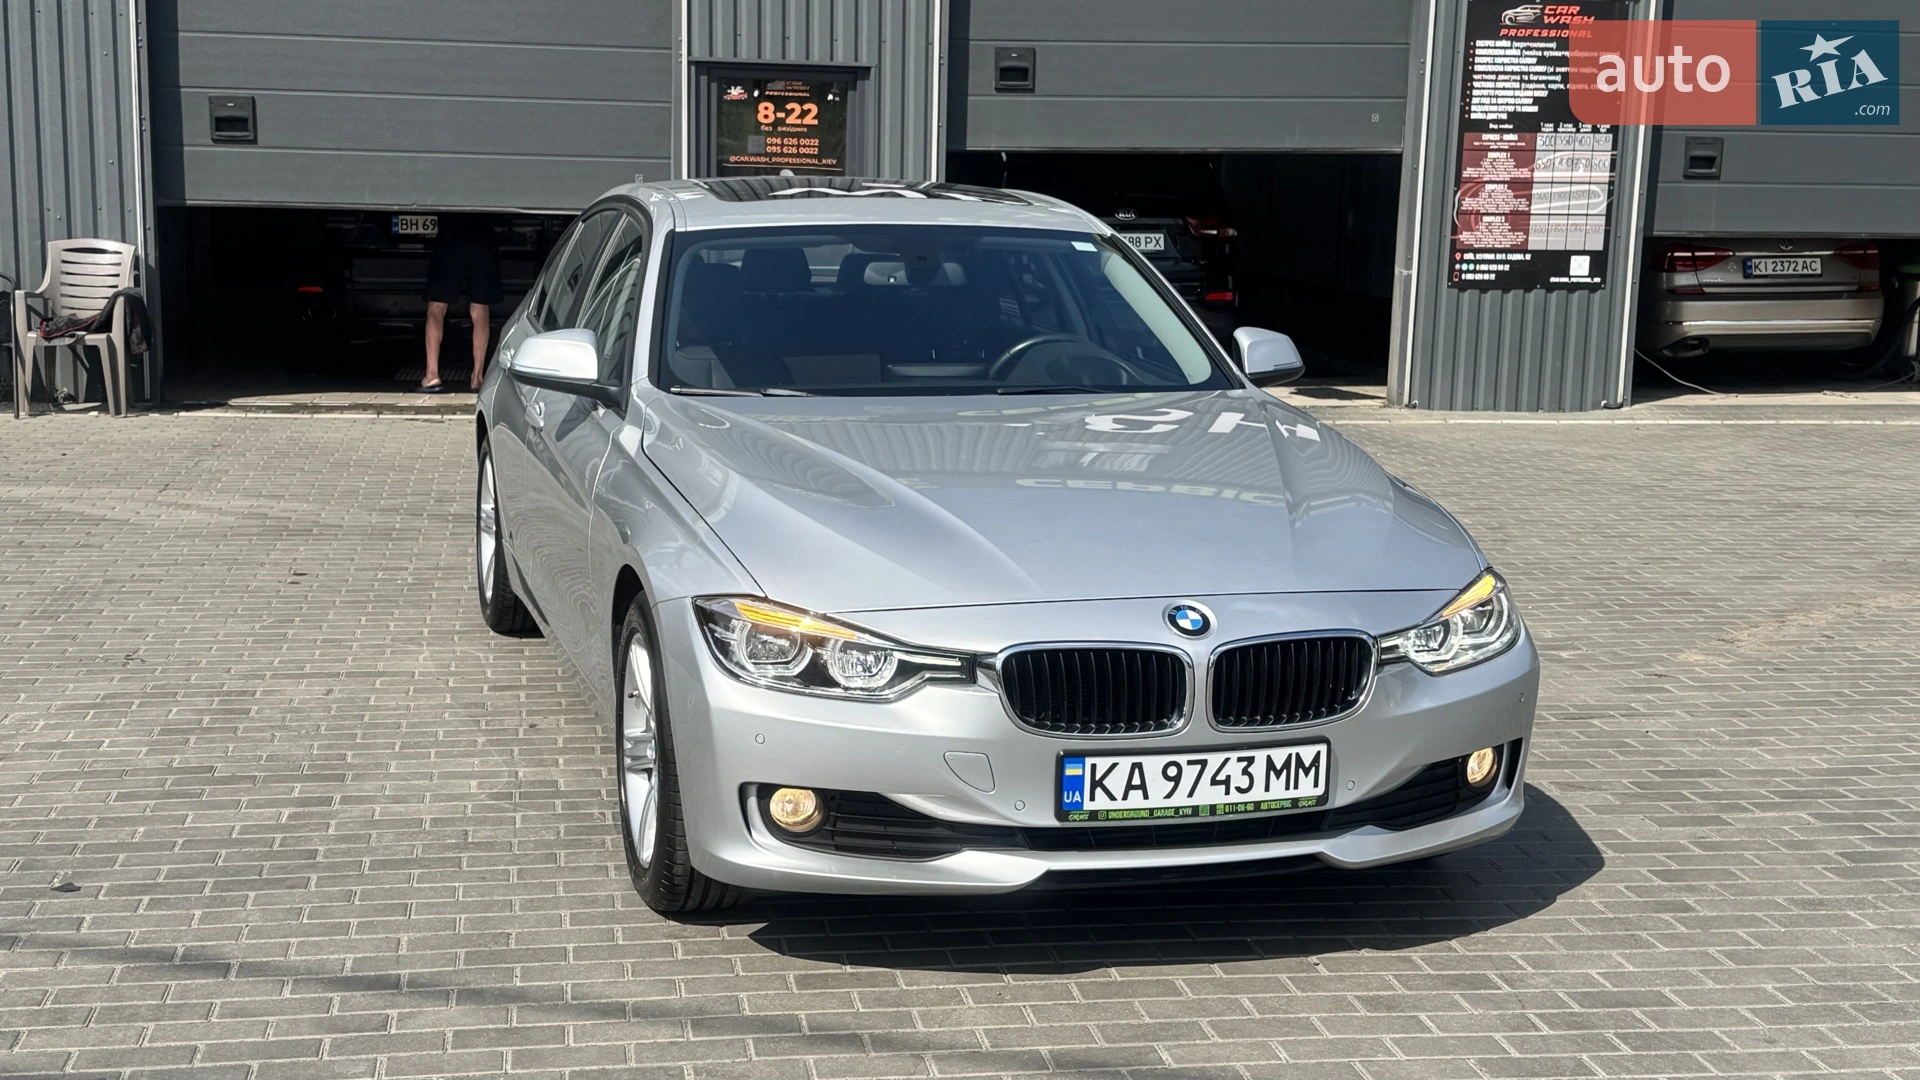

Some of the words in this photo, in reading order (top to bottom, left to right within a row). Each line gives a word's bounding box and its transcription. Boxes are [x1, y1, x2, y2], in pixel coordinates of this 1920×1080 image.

[1544, 6, 1580, 14] CAR
[1543, 16, 1595, 25] WASH
[1500, 28, 1592, 38] PROFESSIONAL
[756, 102, 818, 125] 8-22
[766, 137, 782, 145] 096
[783, 138, 798, 146] 626
[799, 138, 820, 146] 0022
[766, 146, 782, 154] 095
[782, 146, 798, 154] 626
[798, 146, 818, 154] 0022
[400, 218, 418, 231] BH
[1754, 261, 1768, 272] KI
[1771, 260, 1800, 272] 2372
[1800, 260, 1818, 272] AC
[1089, 762, 1150, 802] KA
[1161, 756, 1256, 800] 9743
[1264, 750, 1321, 792] MM
[1064, 791, 1082, 803] UA
